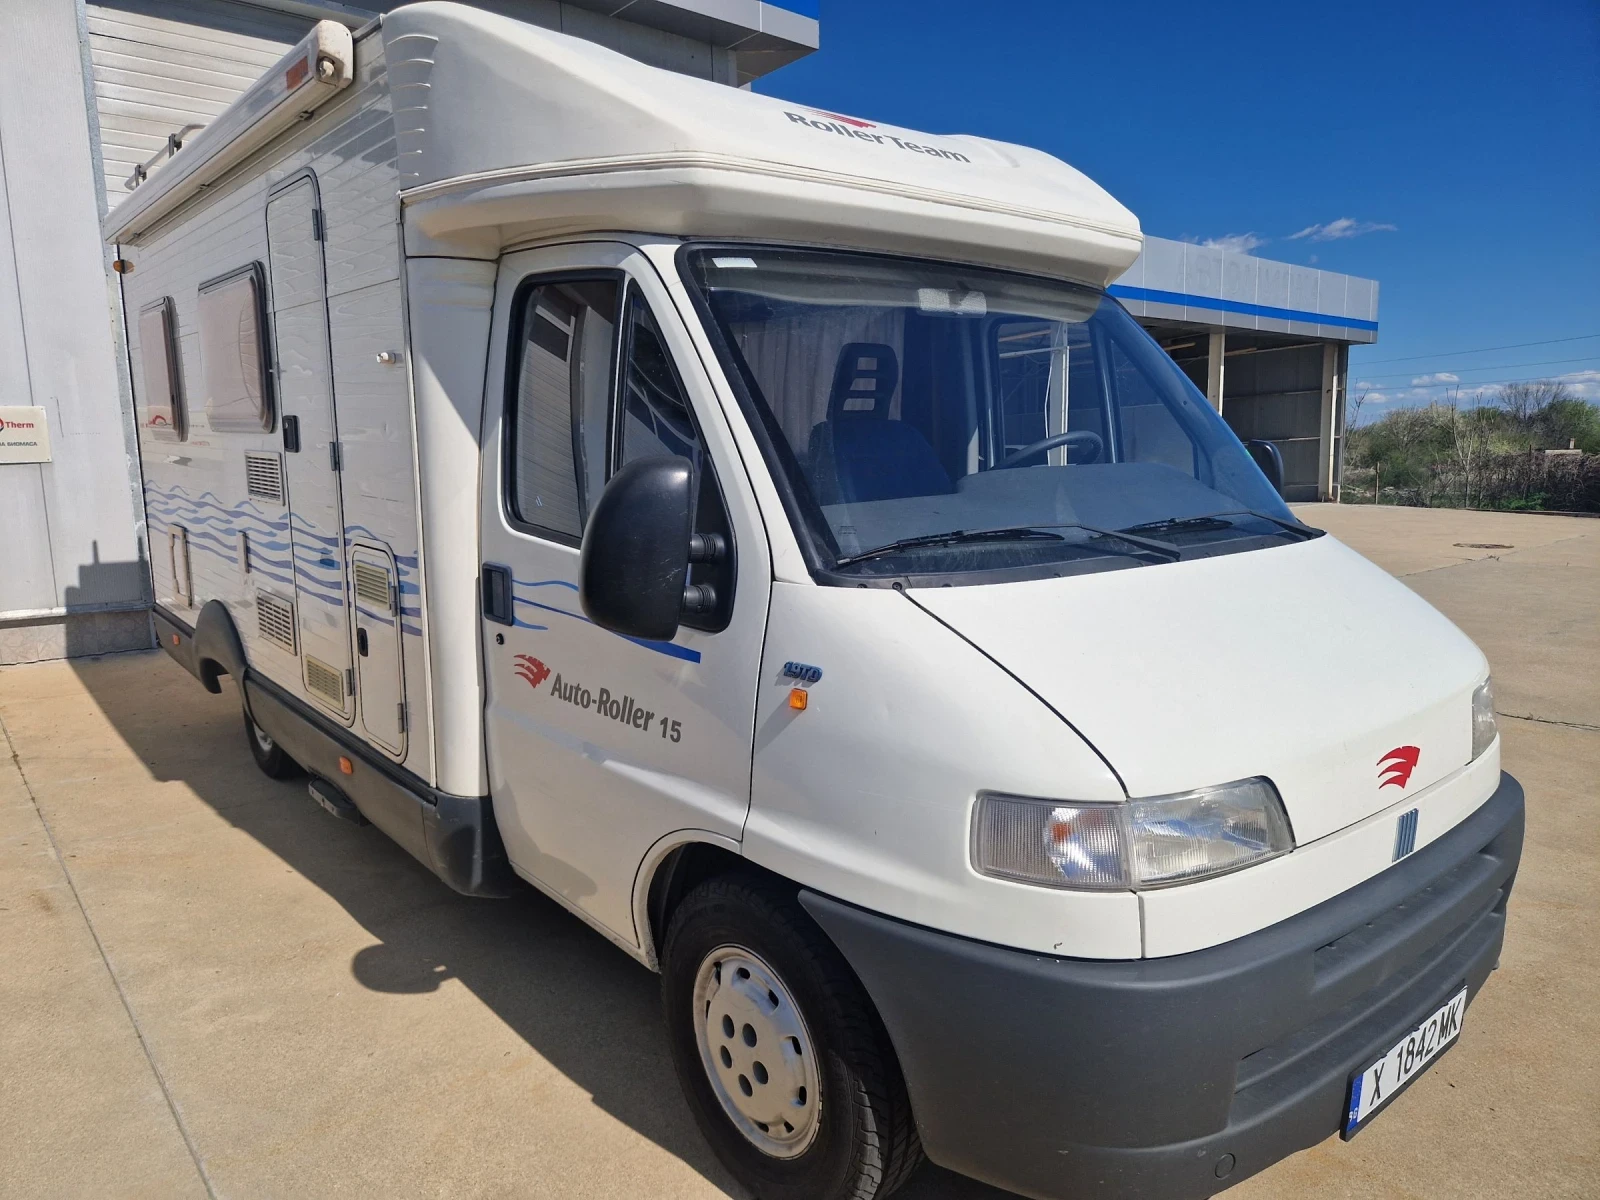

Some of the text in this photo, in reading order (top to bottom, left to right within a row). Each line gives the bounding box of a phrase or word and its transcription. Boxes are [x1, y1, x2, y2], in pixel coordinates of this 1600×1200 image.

[550, 672, 682, 743] Auto-Roller 15
[1369, 1062, 1385, 1107] X
